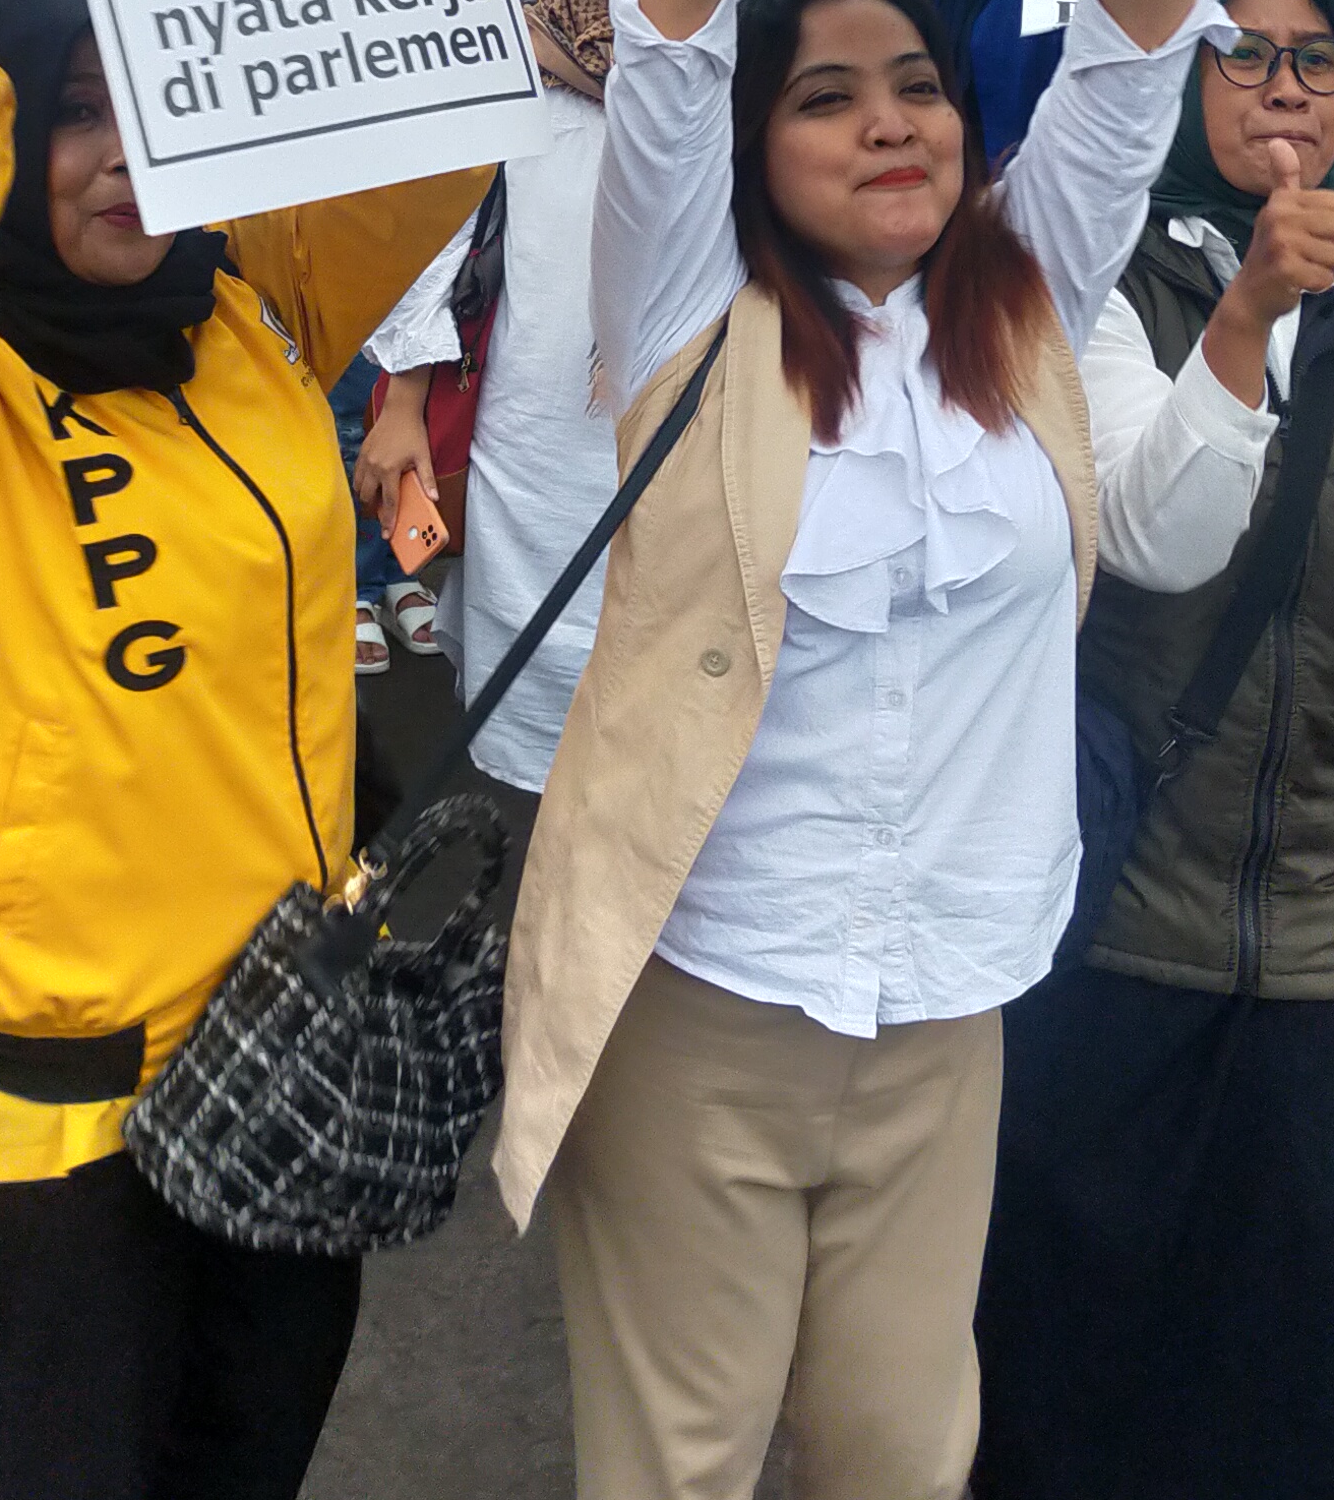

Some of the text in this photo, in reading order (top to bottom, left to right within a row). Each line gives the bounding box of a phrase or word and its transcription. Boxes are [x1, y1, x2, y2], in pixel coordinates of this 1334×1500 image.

[163, 20, 511, 120] di parlemen
[34, 381, 189, 693] KPPG
